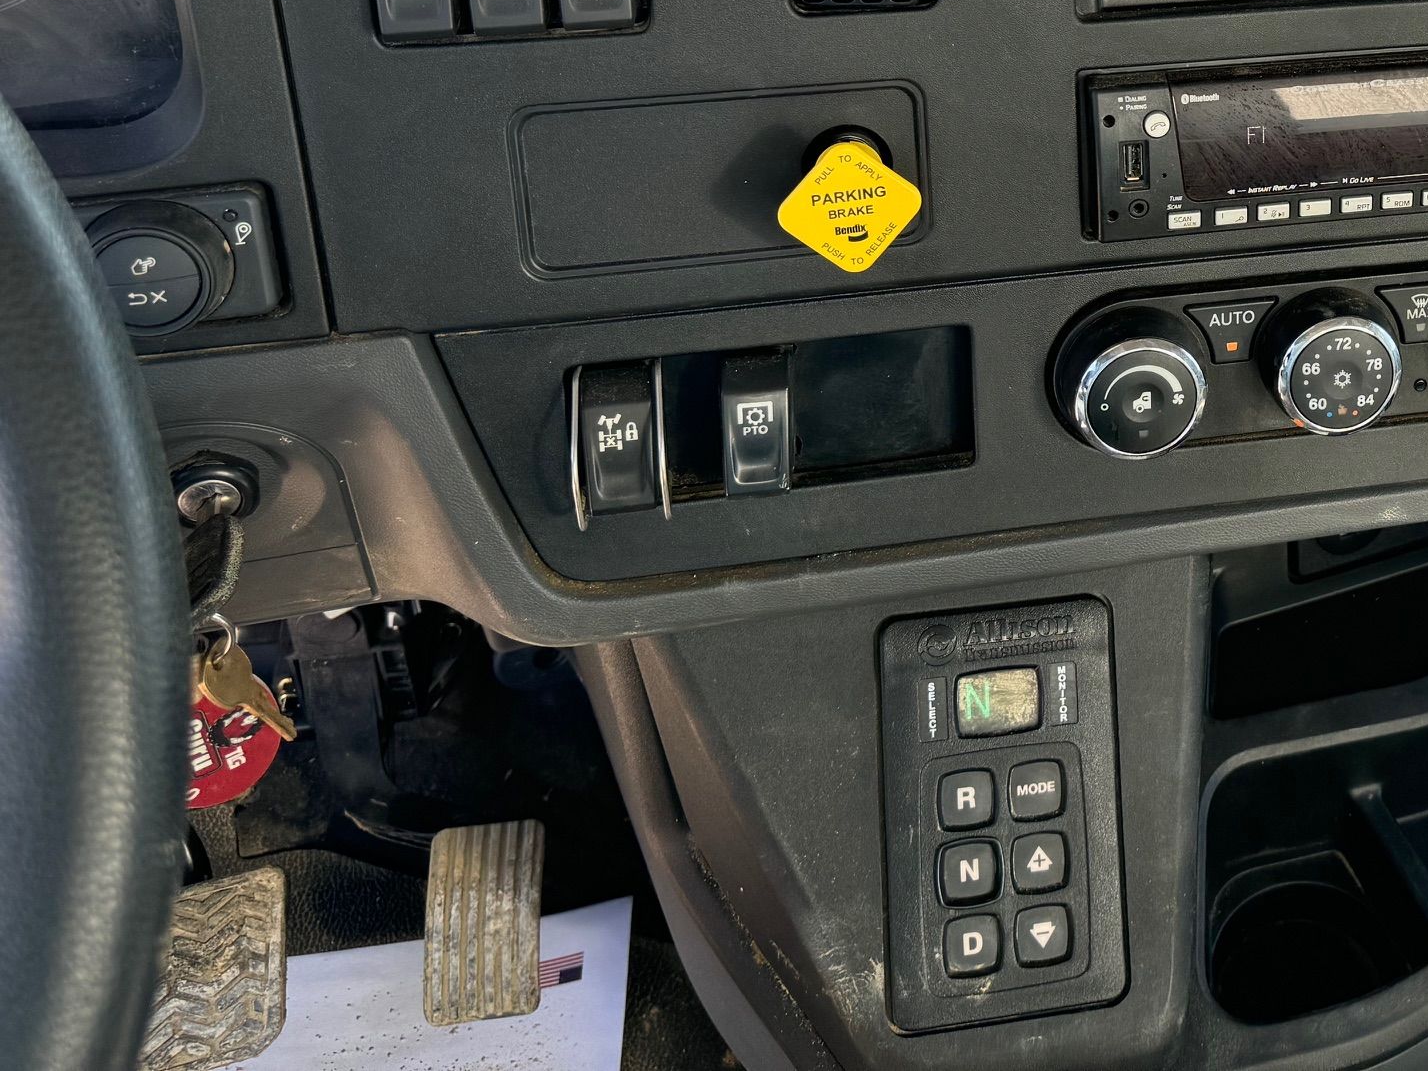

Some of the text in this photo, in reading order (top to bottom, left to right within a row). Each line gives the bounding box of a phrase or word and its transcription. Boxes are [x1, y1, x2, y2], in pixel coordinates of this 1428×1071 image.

[1189, 93, 1220, 103] Bluetooth
[814, 154, 883, 185] PULL TO APPLY
[811, 186, 887, 207] PARKING
[828, 205, 874, 220] BRAKE
[1173, 215, 1192, 224] SCAN
[835, 224, 867, 236] Bendix
[821, 221, 898, 266] PUSH TO RELEASE
[1209, 310, 1255, 327] AUTO
[1334, 337, 1352, 351] 72
[1302, 363, 1320, 375] 66
[1365, 358, 1383, 371] 78
[1308, 398, 1327, 410] 60
[1357, 394, 1374, 407] 84
[743, 425, 768, 436] PTO
[963, 614, 1077, 646] Allison
[964, 639, 1076, 662] Transmission
[964, 679, 991, 721] N
[1057, 666, 1068, 722] MONITOR
[928, 682, 937, 739] SELECT
[1016, 781, 1055, 796] MODE
[957, 786, 976, 810] R
[960, 858, 980, 883] N
[962, 931, 983, 956] D
